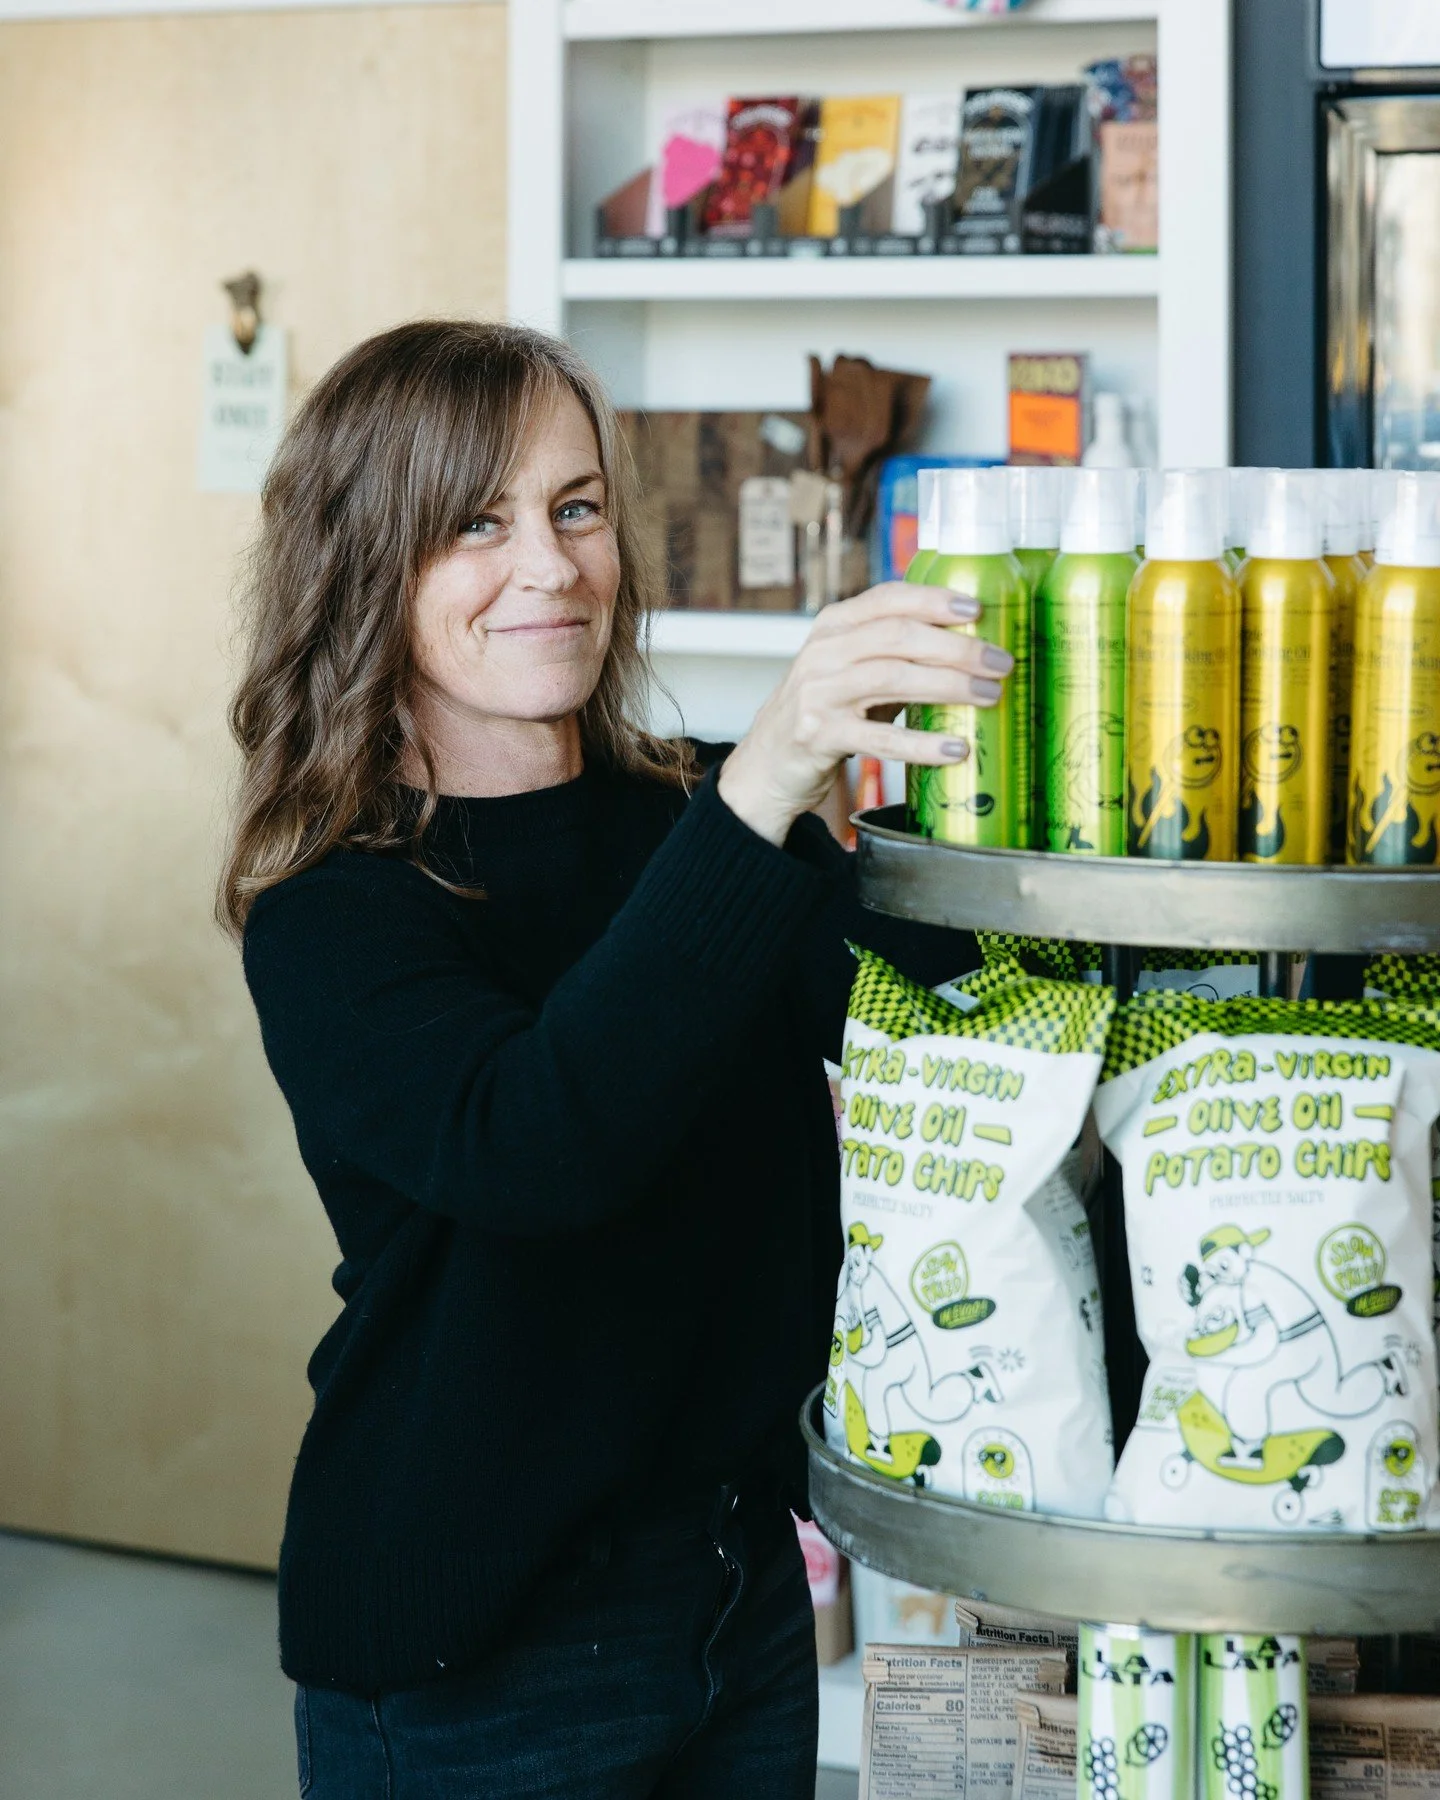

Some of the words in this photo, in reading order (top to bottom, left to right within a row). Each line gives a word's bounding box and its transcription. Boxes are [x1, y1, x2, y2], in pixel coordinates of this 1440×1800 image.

[1292, 1091, 1343, 1131] Oil
[921, 1102, 966, 1147] Oil
[1019, 1633, 1049, 1644] Facts
[930, 1657, 962, 1668] Facts
[876, 1700, 921, 1711] Calories
[945, 1699, 965, 1712] 80
